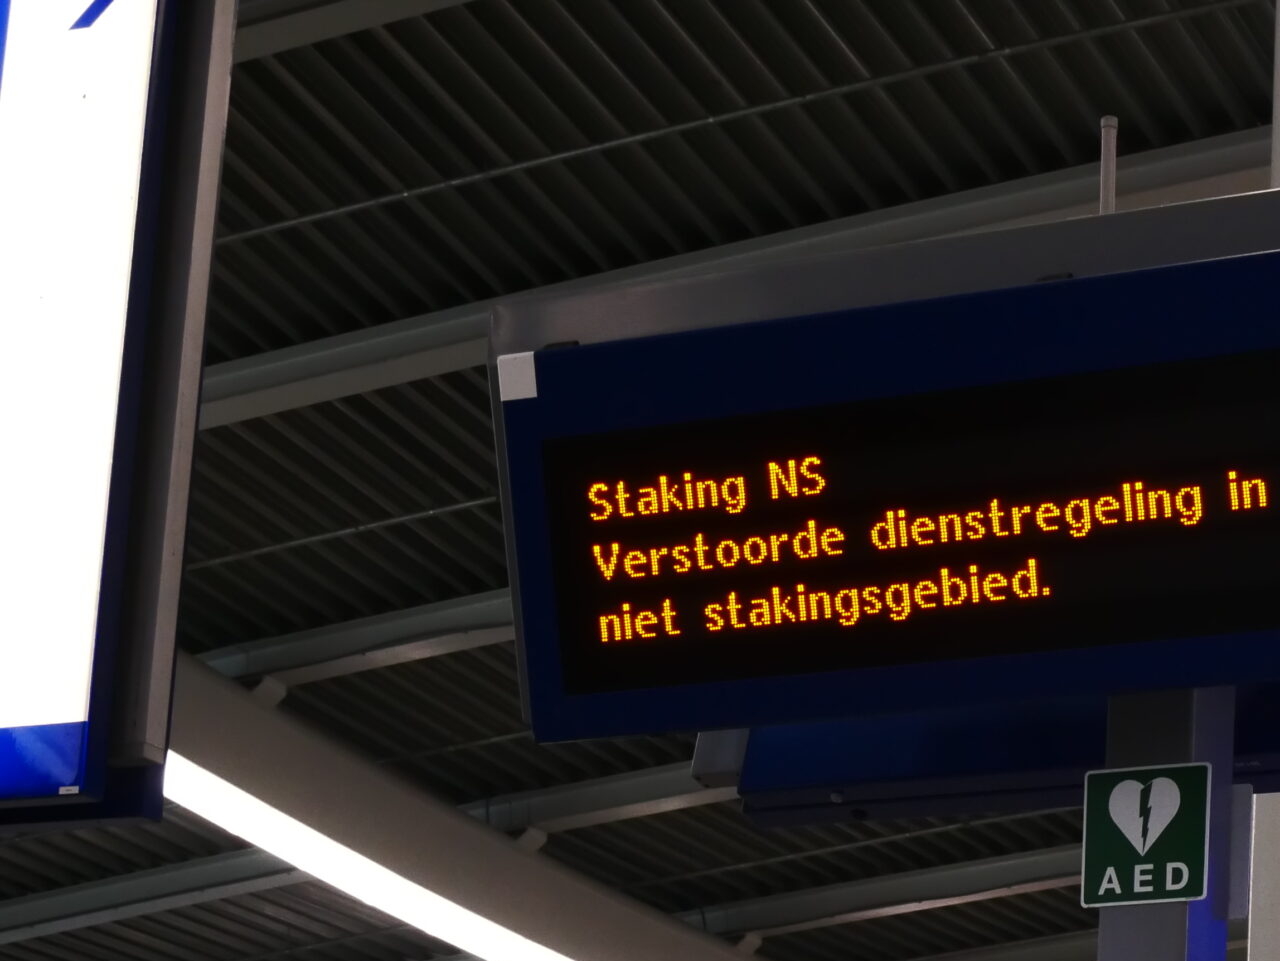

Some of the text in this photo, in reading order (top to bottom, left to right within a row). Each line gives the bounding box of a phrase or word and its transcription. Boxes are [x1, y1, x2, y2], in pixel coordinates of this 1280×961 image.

[587, 456, 826, 521] Staking NS
[592, 470, 1268, 581] Verstoorde dienstregeling in
[599, 558, 1051, 643] niet stakingsgebied.
[1098, 861, 1190, 896] AED
